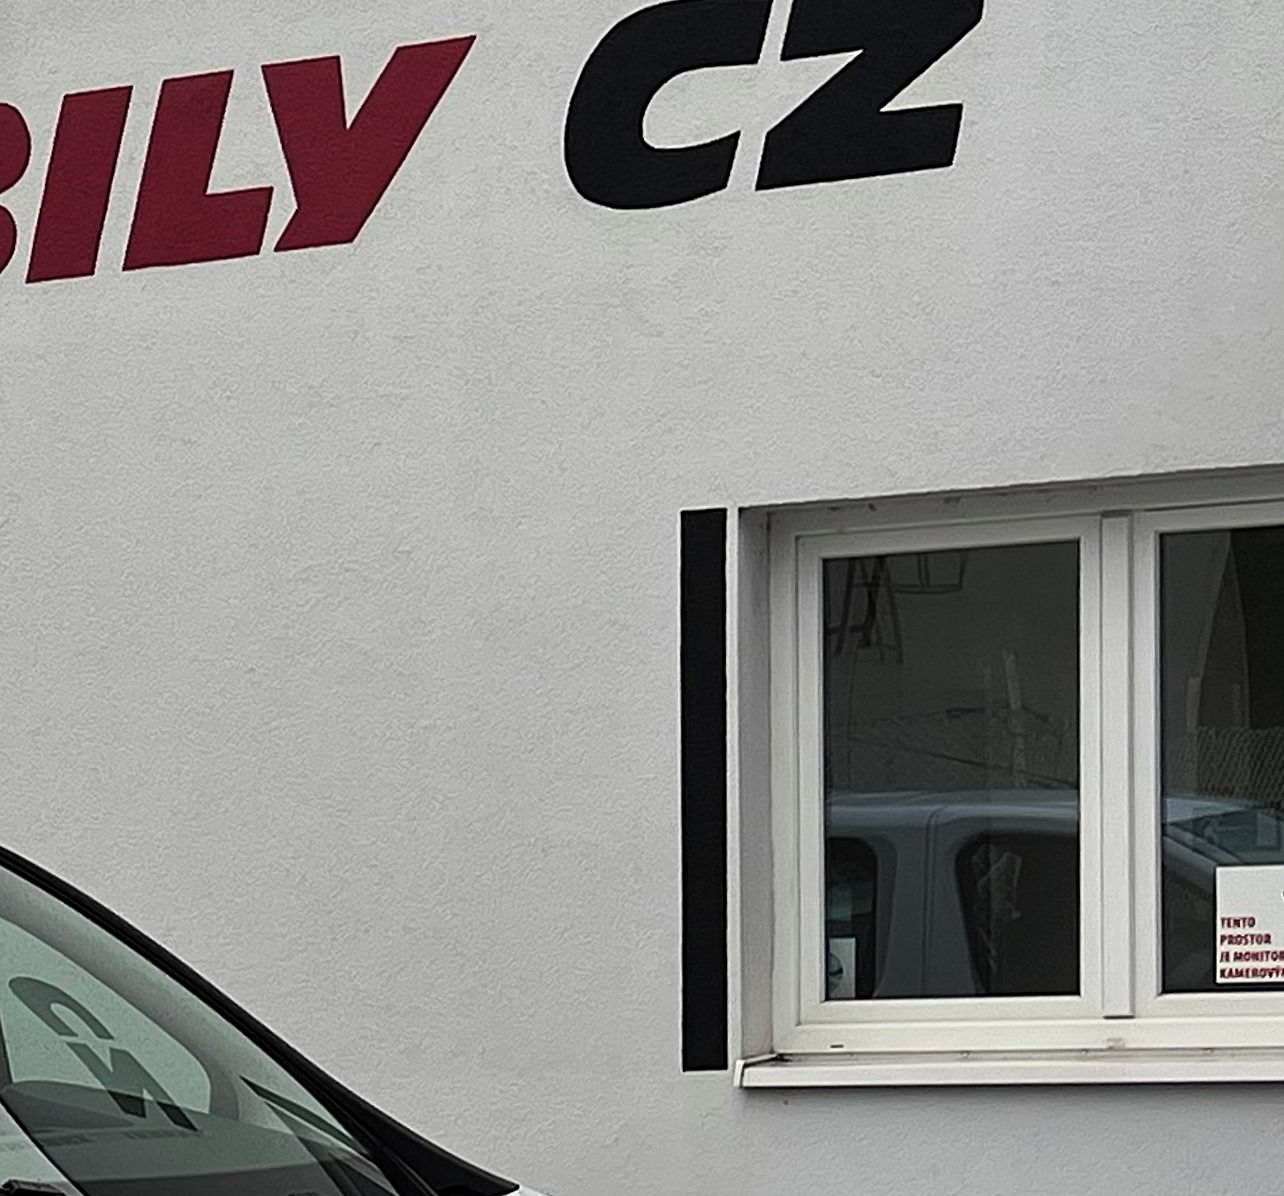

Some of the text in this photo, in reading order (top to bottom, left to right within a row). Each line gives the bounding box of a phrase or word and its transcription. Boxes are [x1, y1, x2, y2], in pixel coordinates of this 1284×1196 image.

[564, 0, 985, 210] CZ
[1220, 916, 1256, 928] TENTO
[1220, 933, 1272, 946] PROSTOR
